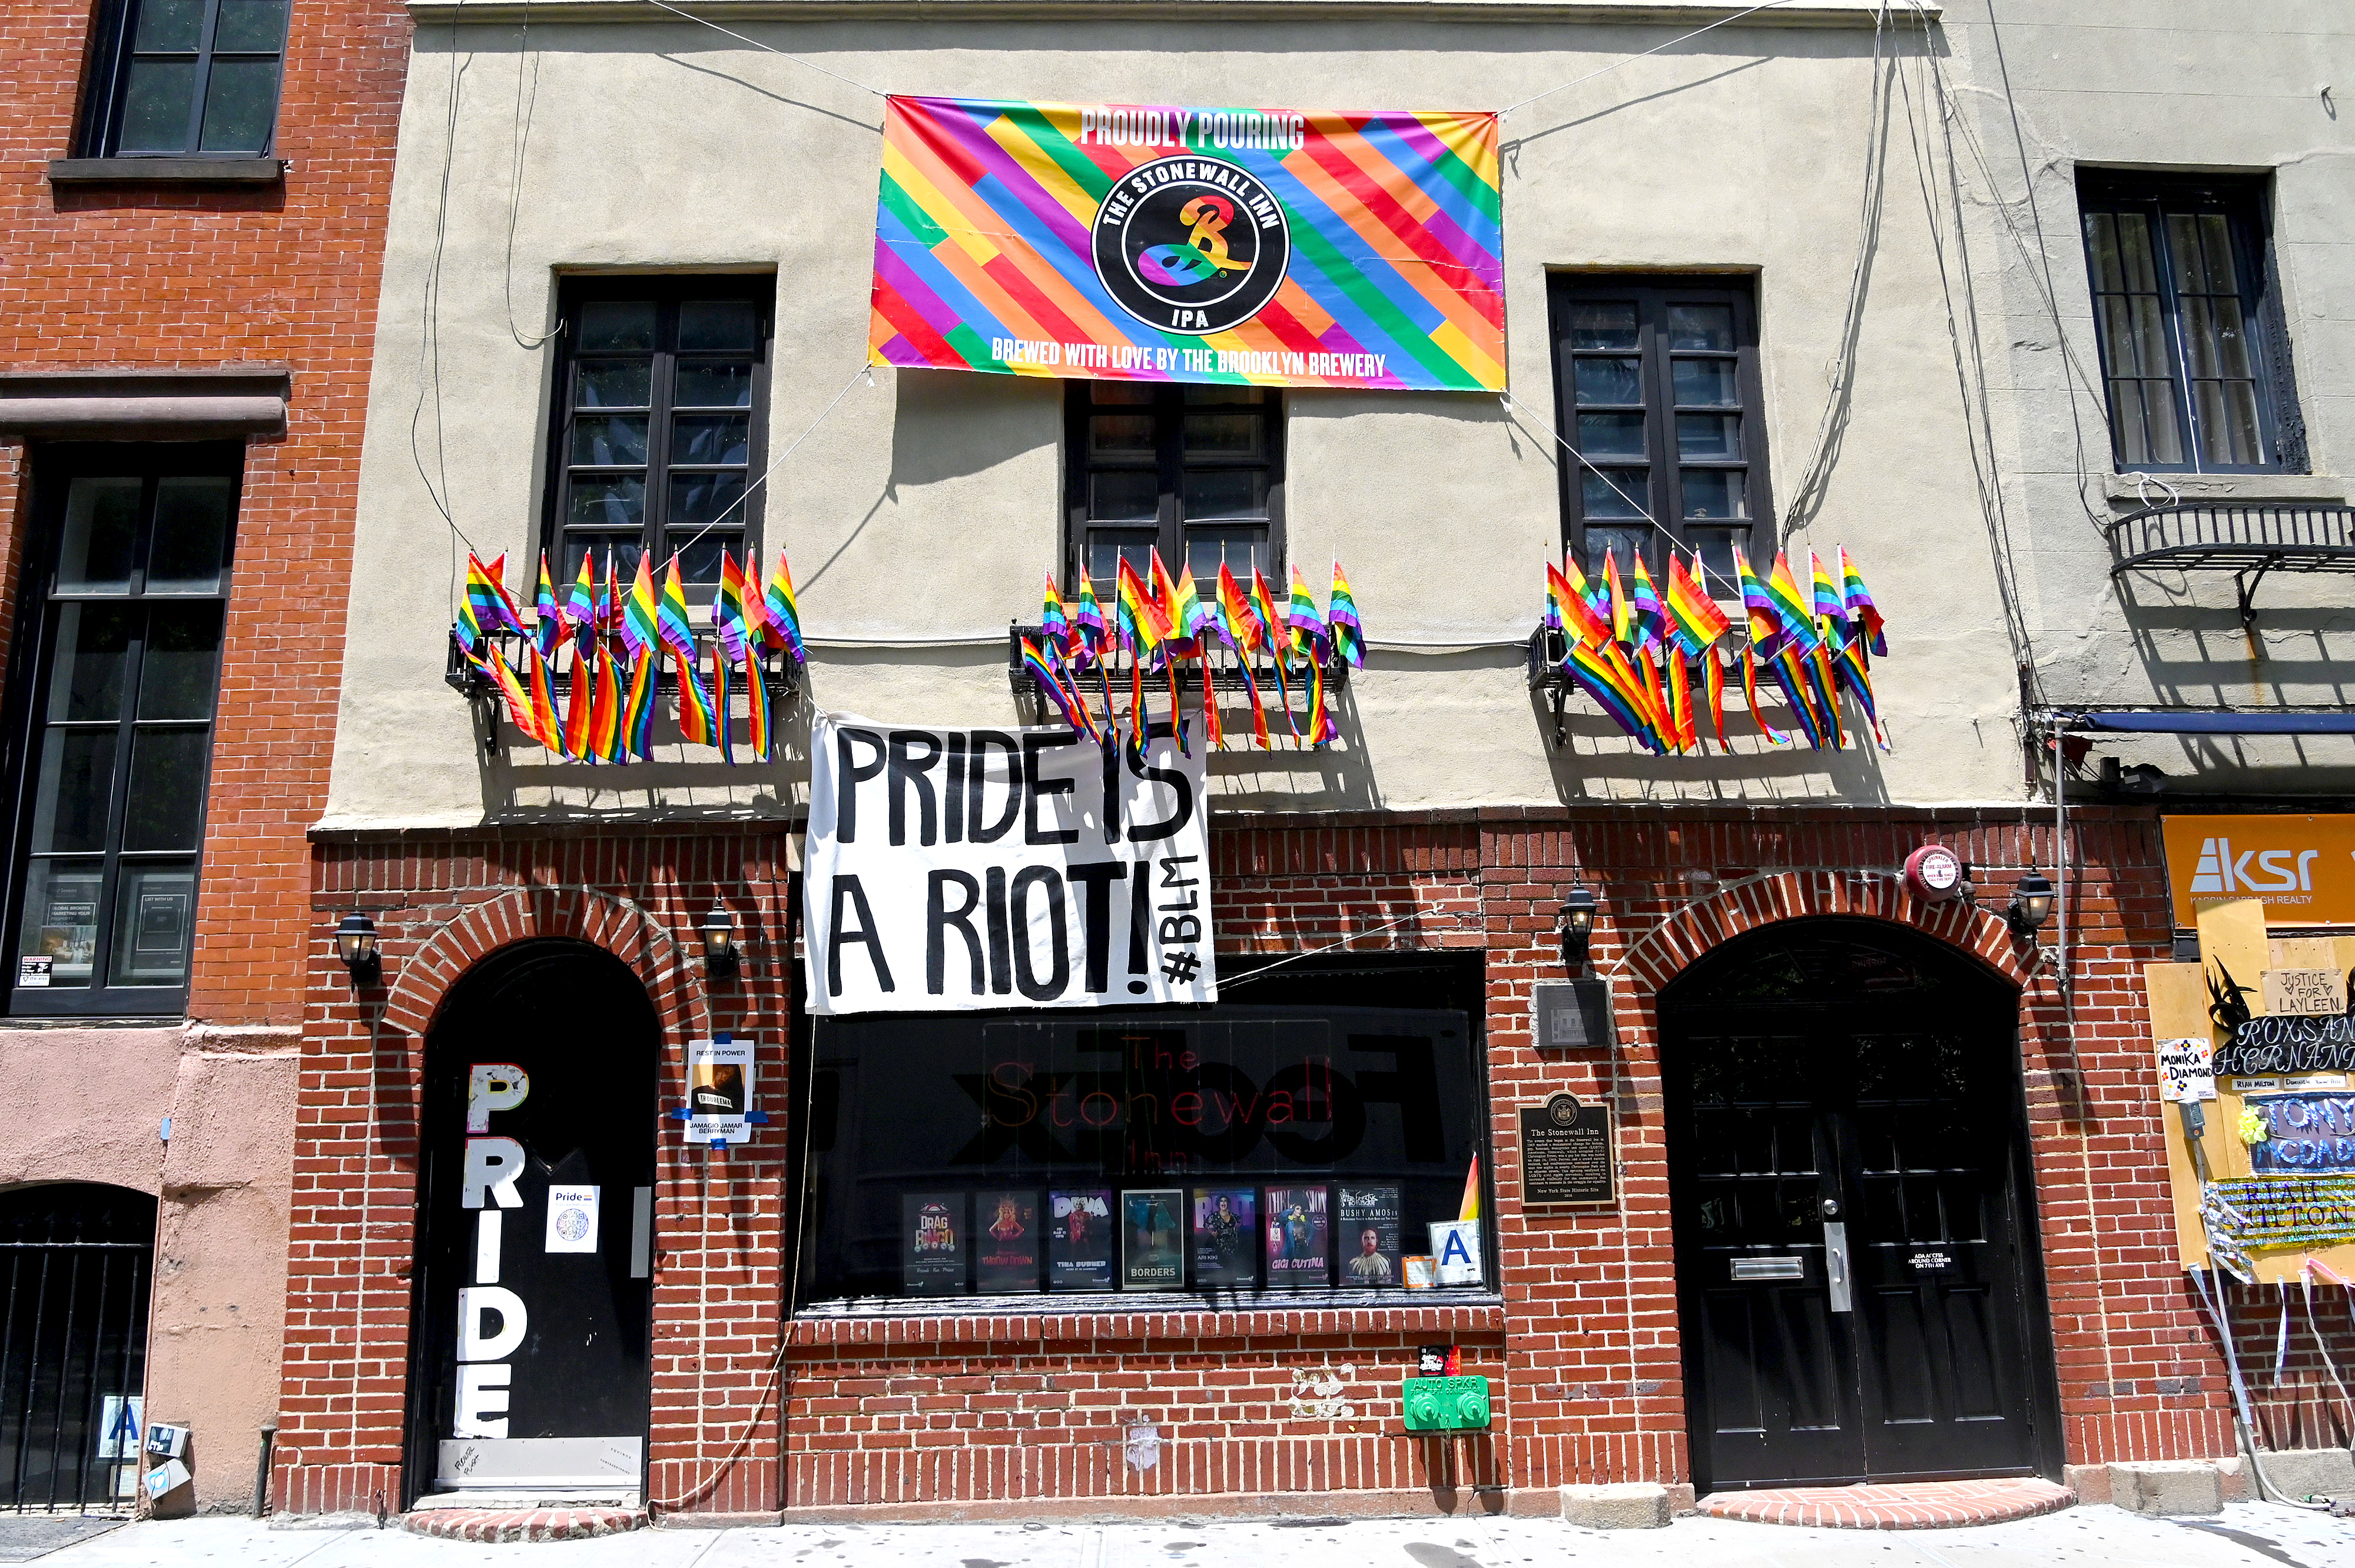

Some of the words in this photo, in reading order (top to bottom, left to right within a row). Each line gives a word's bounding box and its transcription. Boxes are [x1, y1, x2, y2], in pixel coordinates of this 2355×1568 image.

[1081, 109, 1192, 148] PROUDLY
[1198, 113, 1305, 151] POURING
[1102, 190, 1135, 227] THE
[1130, 162, 1251, 198] STONEWALL
[1248, 193, 1281, 230] INN
[1171, 309, 1209, 328] IPA
[992, 337, 1060, 366] BREWED
[1064, 342, 1108, 368] WITH
[1111, 345, 1153, 371] LOVE
[1156, 348, 1178, 372] BY
[1182, 348, 1215, 374] THE
[1216, 349, 1306, 376] BROOKLYN
[1308, 353, 1386, 378] BREWERY
[836, 727, 1080, 846] PRIDE
[1103, 719, 1193, 845] IS
[1926, 855, 1949, 864] SPRINKLER
[2277, 895, 2313, 904] REALTY
[1158, 855, 1202, 985] #BLM
[828, 873, 895, 998] A
[927, 861, 1151, 1001] RIOT!
[2280, 973, 2328, 986] JUSTICE
[2298, 987, 2321, 998] FOR
[2279, 998, 2340, 1014] LAYLEEN
[1120, 1036, 1199, 1070] The
[2161, 1052, 2201, 1066] MONIKA
[2170, 1067, 2213, 1081] DIAMOND
[987, 1055, 1332, 1127] Stonewall
[2258, 1098, 2355, 1131] TONY
[2256, 1137, 2355, 1168] MCDAD
[556, 1192, 582, 1201] Pride
[921, 1215, 948, 1230] DRAG
[916, 1228, 954, 1246] BINGO
[455, 1062, 529, 1440] PRIDE
[1441, 1230, 1472, 1265] A
[1131, 1267, 1176, 1277] BORDERS
[1272, 1258, 1289, 1269] GIGI
[1291, 1257, 1324, 1268] CUTINA
[1413, 1378, 1442, 1390] AUTO
[108, 1404, 139, 1440] A
[611, 1447, 631, 1459] EQUINOX
